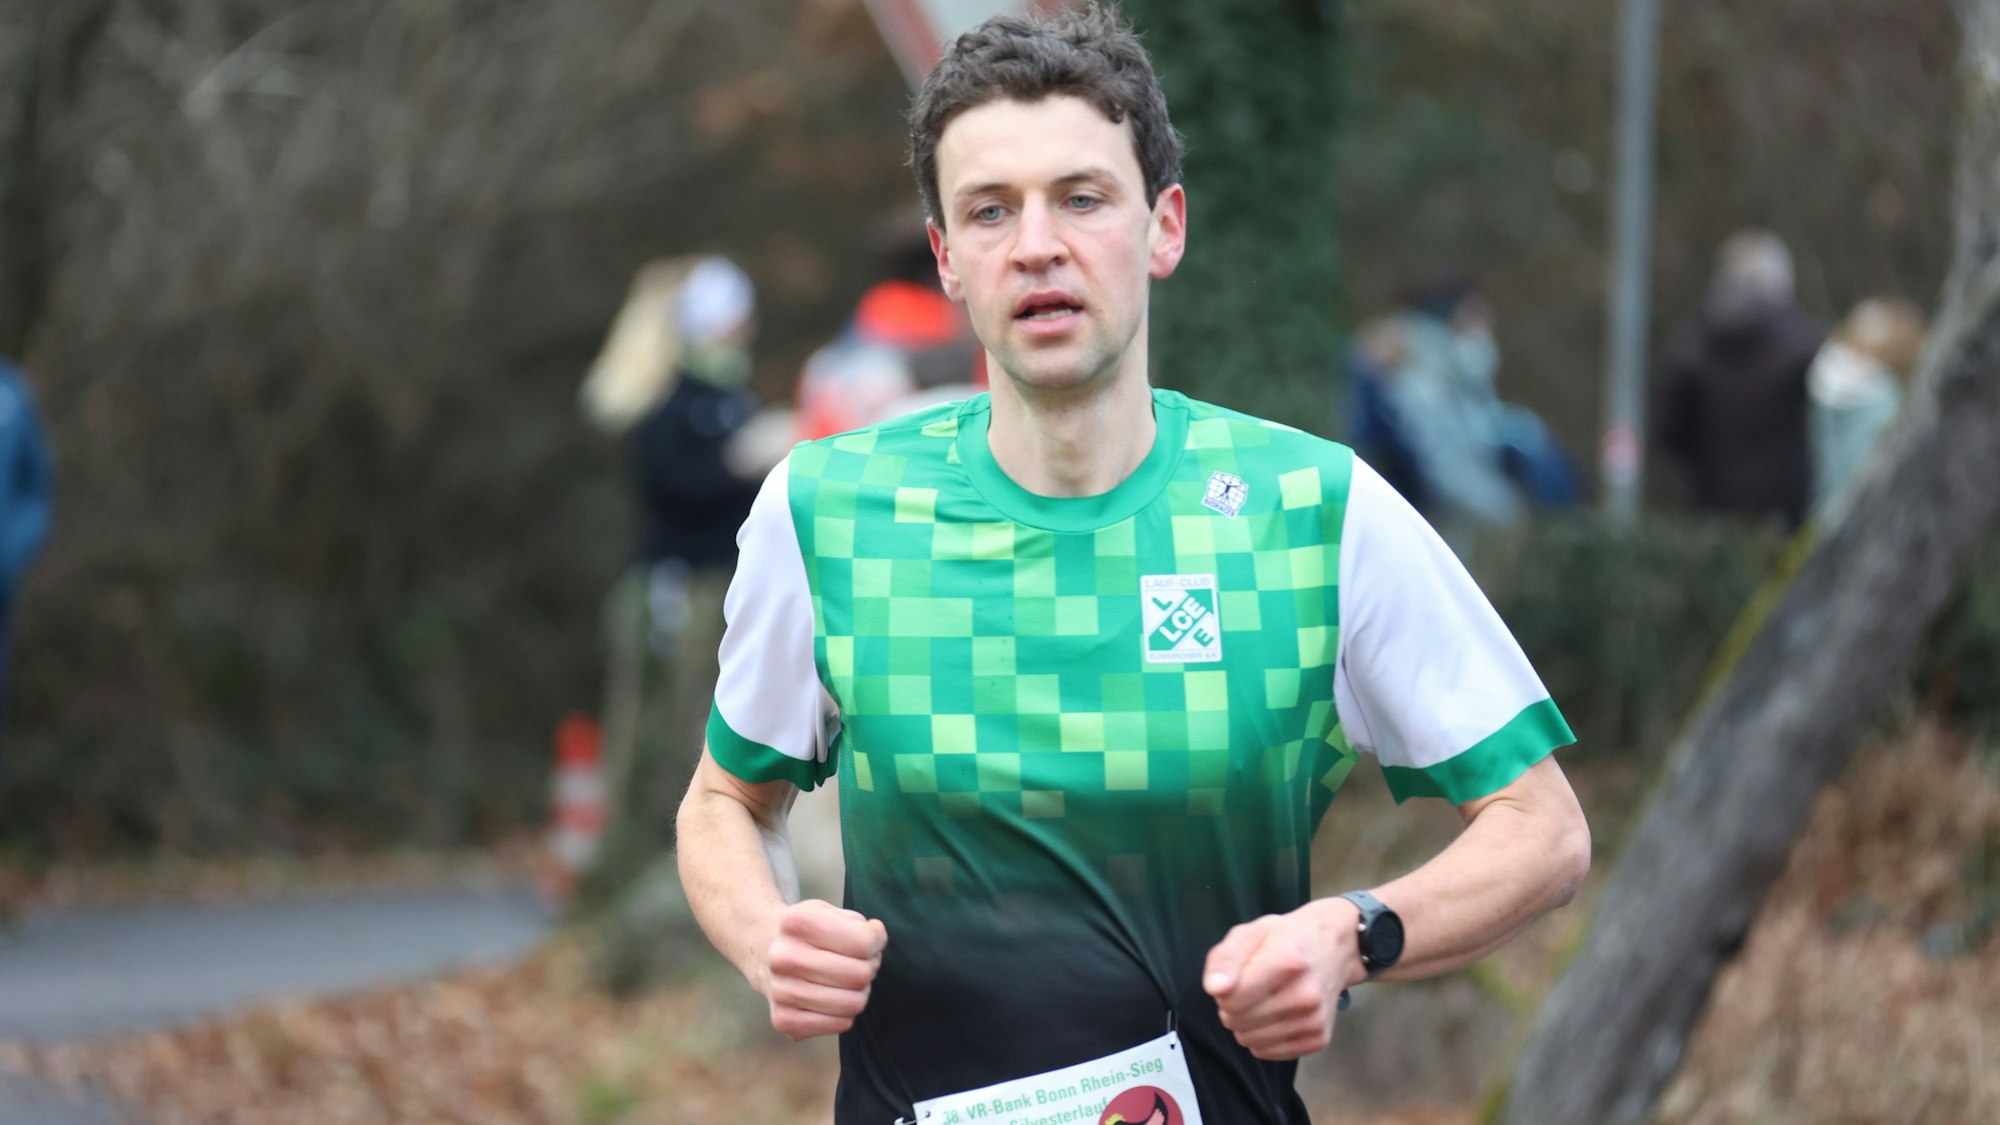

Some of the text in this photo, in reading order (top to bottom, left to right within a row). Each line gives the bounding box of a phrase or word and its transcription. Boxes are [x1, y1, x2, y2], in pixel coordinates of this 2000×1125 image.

[1145, 576, 1210, 588] LAUF-CLUB
[1159, 596, 1207, 643] LCE
[943, 1058, 1164, 1125] 38. VR-Bank Bonn Rhein-Sieg
